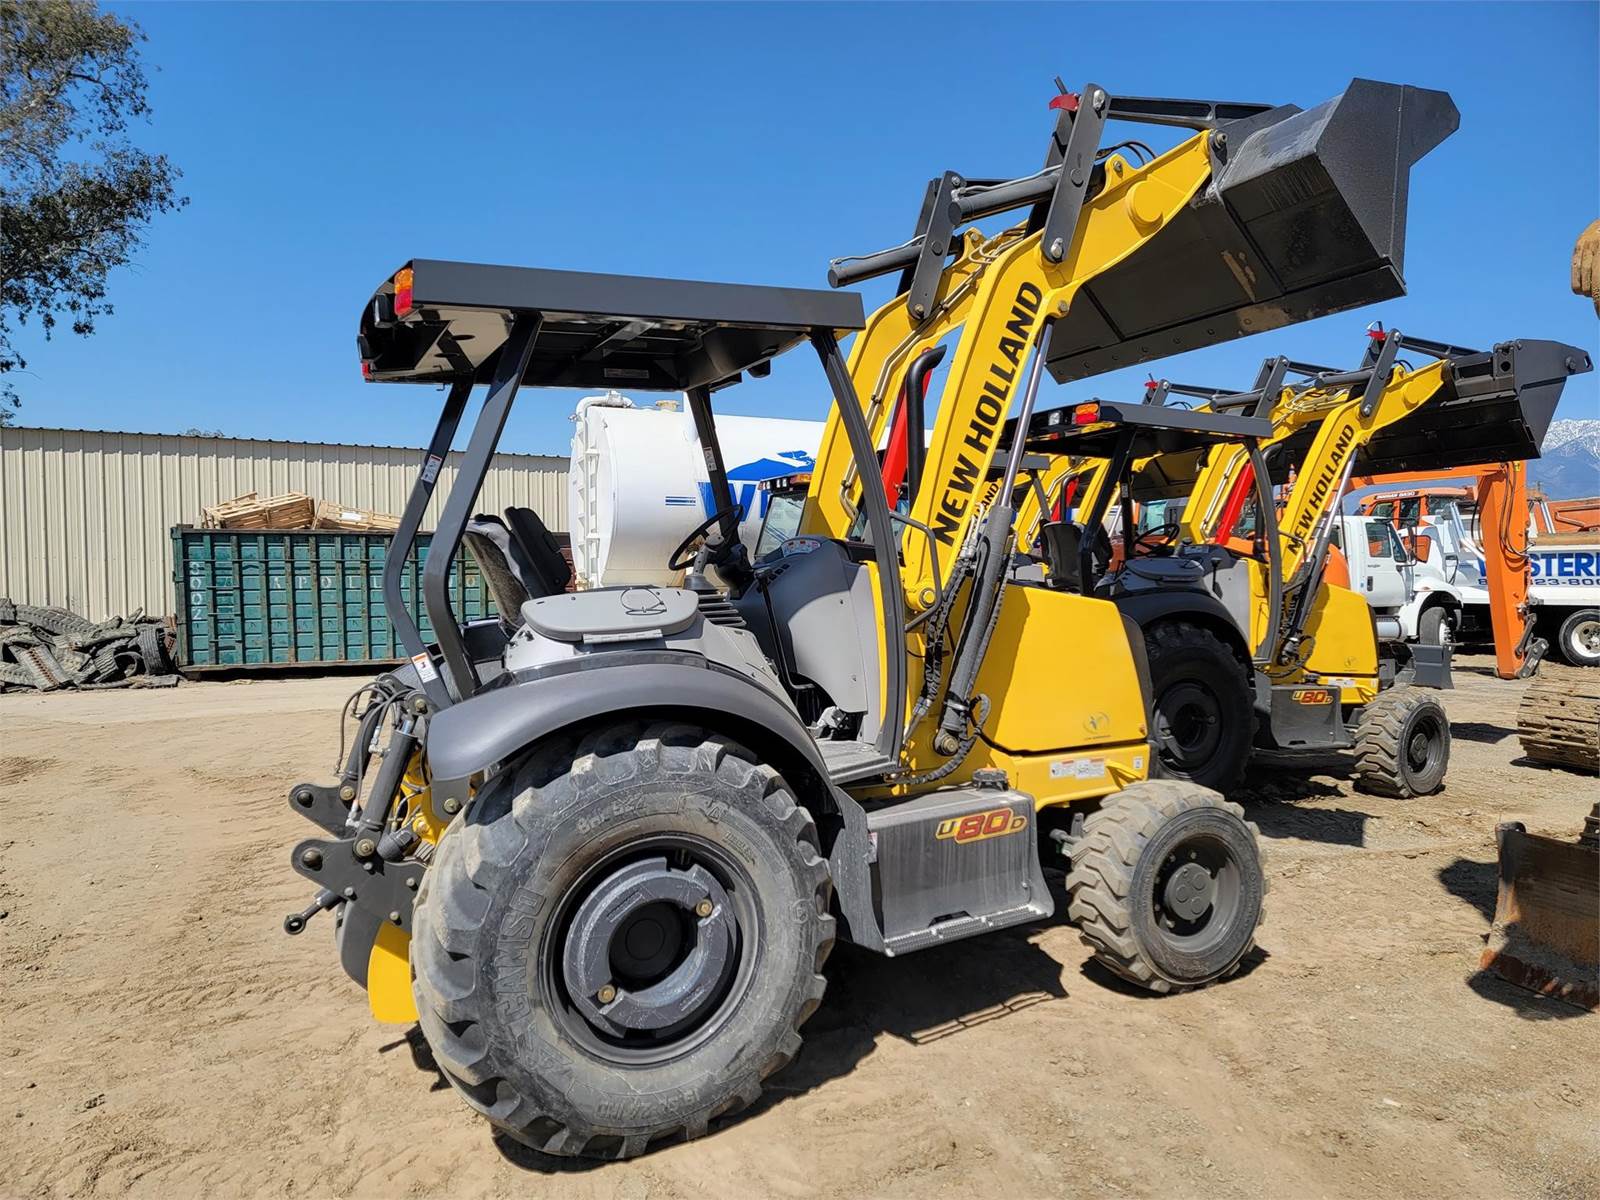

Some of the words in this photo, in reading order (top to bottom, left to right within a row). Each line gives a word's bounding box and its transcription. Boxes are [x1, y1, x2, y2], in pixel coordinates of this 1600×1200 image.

[932, 454, 981, 545] NEW
[964, 281, 1043, 454] HOLLAND
[1287, 508, 1314, 555] NEW
[1309, 424, 1355, 510] HOLLAND
[495, 888, 547, 1026] CAMSO
